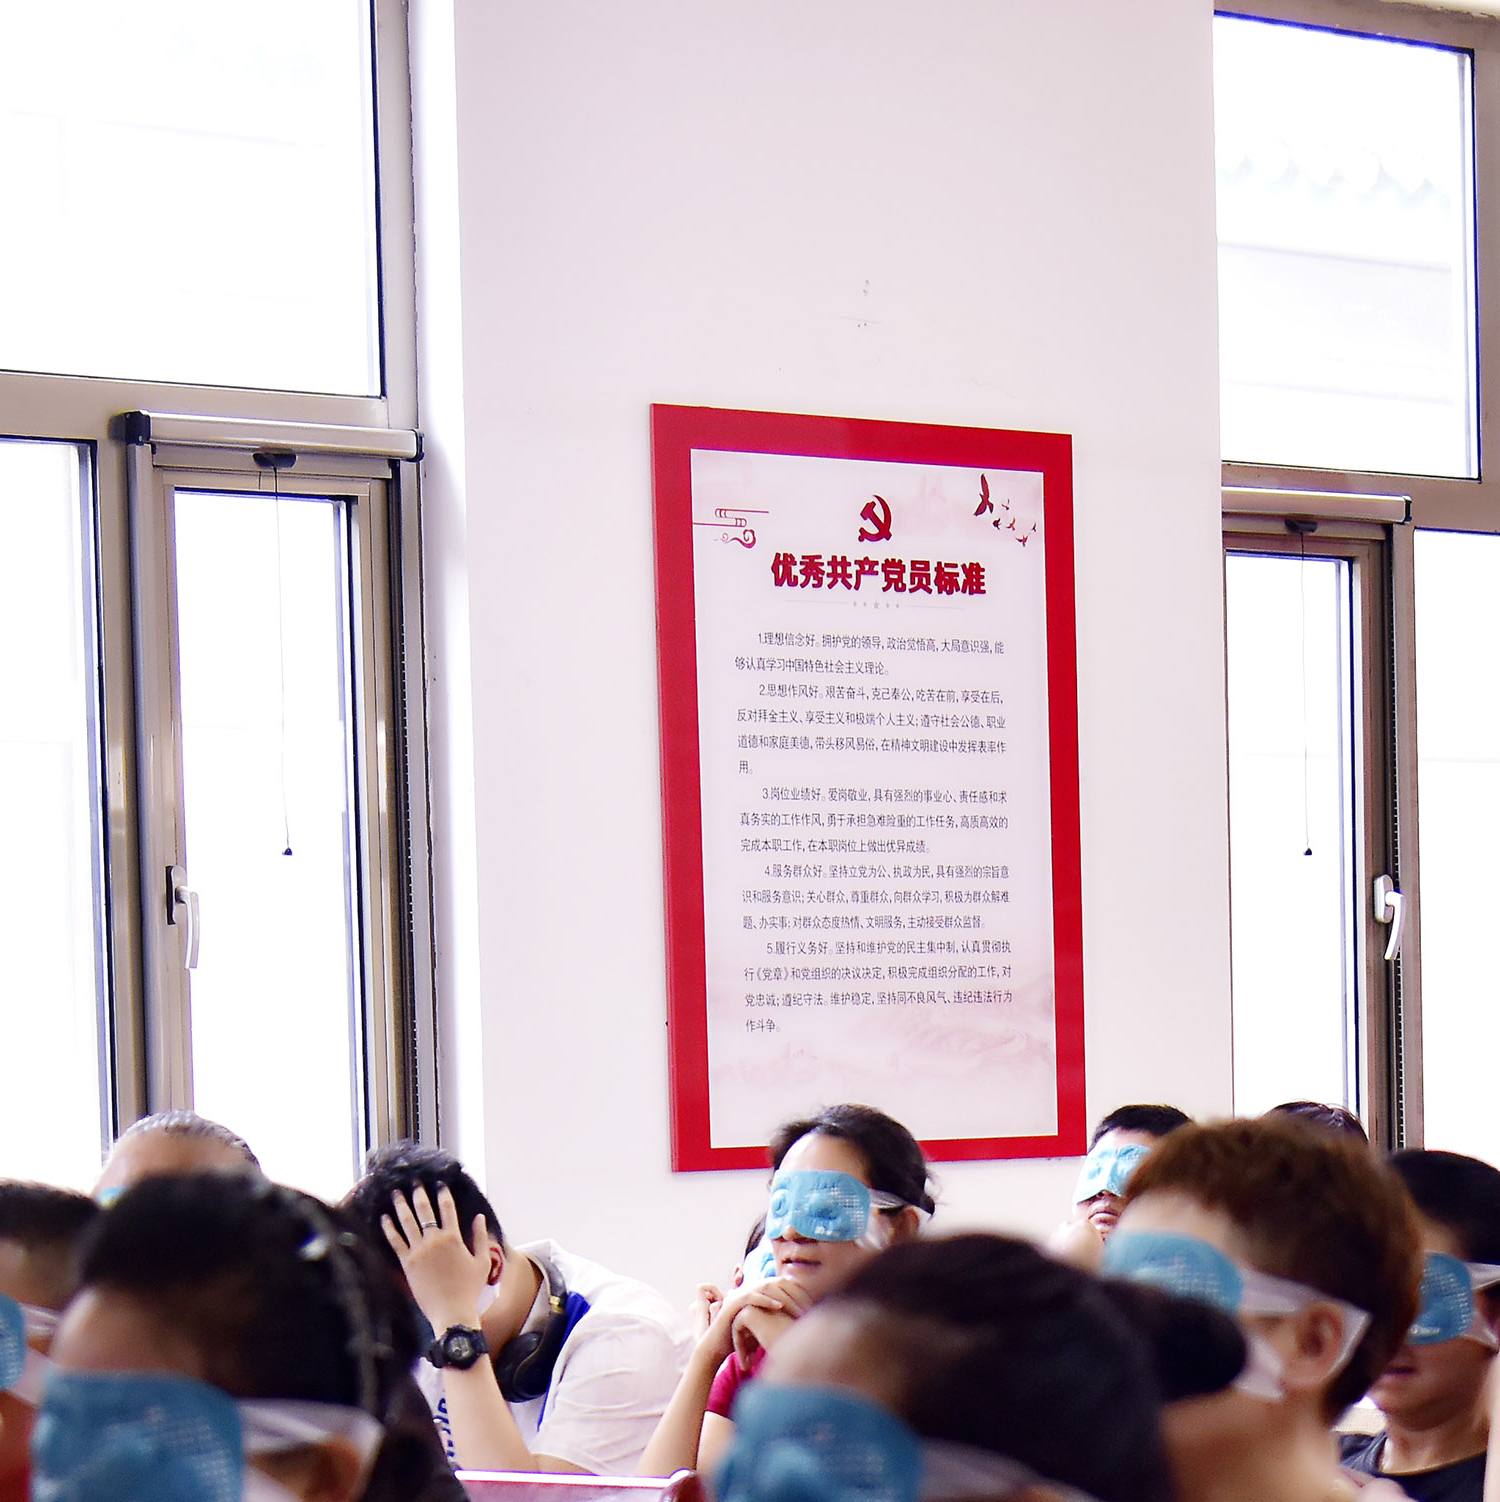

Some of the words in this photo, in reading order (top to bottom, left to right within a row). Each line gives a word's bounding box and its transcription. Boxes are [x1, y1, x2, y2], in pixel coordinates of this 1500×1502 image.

[771, 552, 987, 596] 优秀共产党员标准
[734, 656, 889, 676] 够认真学习中国特色社会主义理论。
[739, 760, 753, 775] 用。
[746, 1018, 780, 1033] 作斗争。
